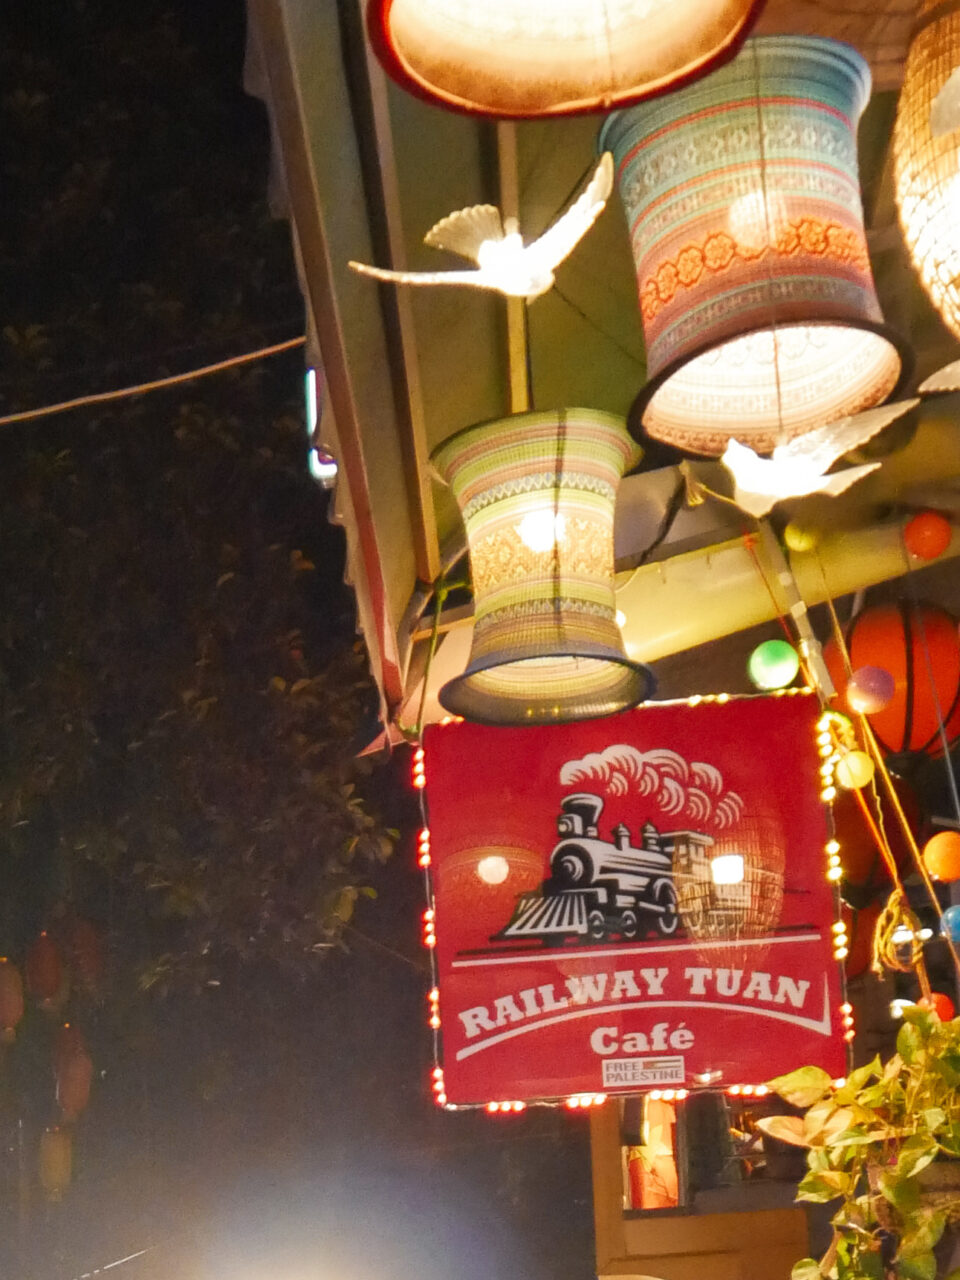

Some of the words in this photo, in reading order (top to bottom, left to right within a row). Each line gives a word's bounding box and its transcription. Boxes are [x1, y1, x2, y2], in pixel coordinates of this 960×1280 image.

[458, 967, 669, 1039] RAILWAY
[685, 966, 811, 1009] TUAN
[590, 1023, 696, 1056] Café
[605, 1070, 684, 1083] PALESTINE
[606, 1062, 640, 1072] FREE
